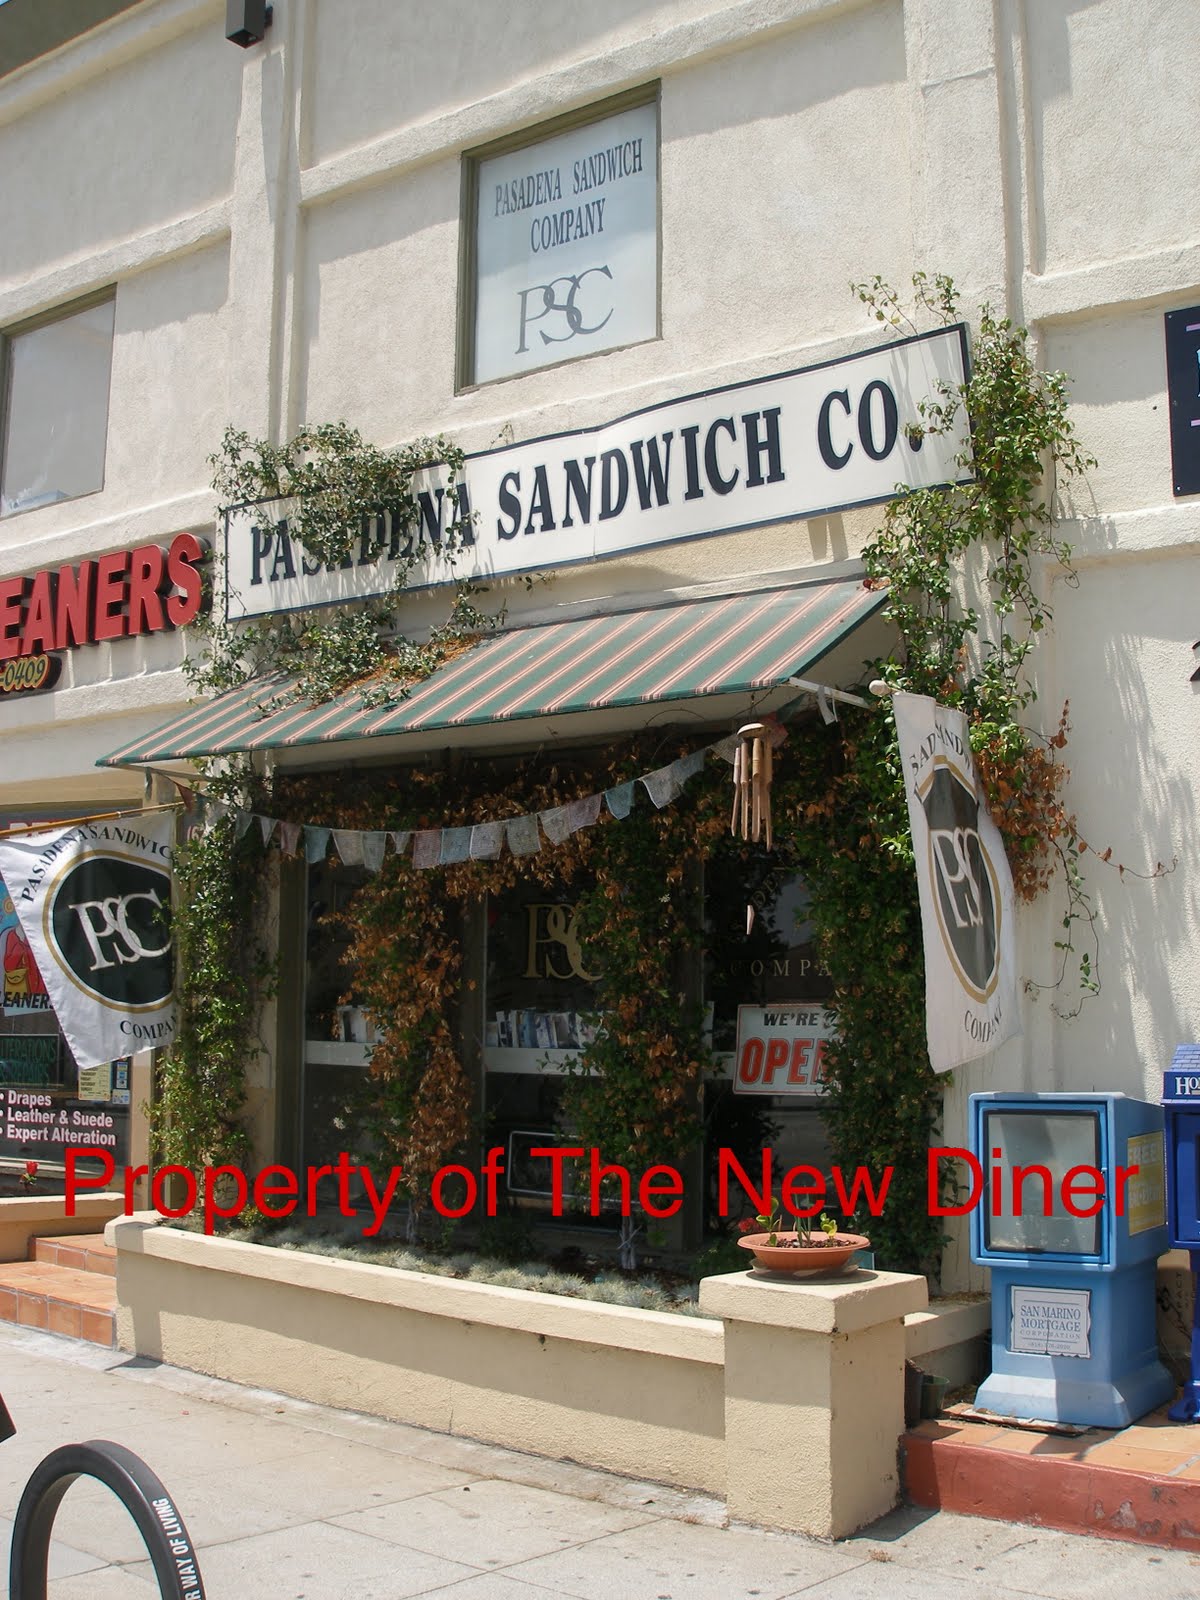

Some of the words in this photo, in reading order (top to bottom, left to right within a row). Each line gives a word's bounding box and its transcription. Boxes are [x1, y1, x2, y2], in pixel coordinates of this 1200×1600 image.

[494, 167, 562, 217] PASADENA
[572, 138, 643, 195] SANDWICH
[530, 197, 606, 254] COMPANY
[515, 265, 614, 355] PSC
[250, 482, 476, 586] PADENA
[496, 406, 785, 541] SANDWICH
[0, 991, 55, 1009] EANER
[763, 1012, 820, 1027] WE'RE
[1175, 1076, 1200, 1096] HO
[8, 1089, 52, 1108] Drapes
[7, 1107, 56, 1124] Leather
[59, 1109, 69, 1125] &
[73, 1110, 113, 1128] Suede
[7, 1124, 49, 1142] Expert
[51, 1127, 117, 1146] Alteration
[1020, 1305, 1040, 1317] SAN
[1041, 1306, 1082, 1320] MARINO
[1020, 1318, 1081, 1332] MORTGAGE
[152, 1498, 182, 1537] LIVING
[169, 1539, 189, 1556] OF
[175, 1558, 198, 1589] WAY
